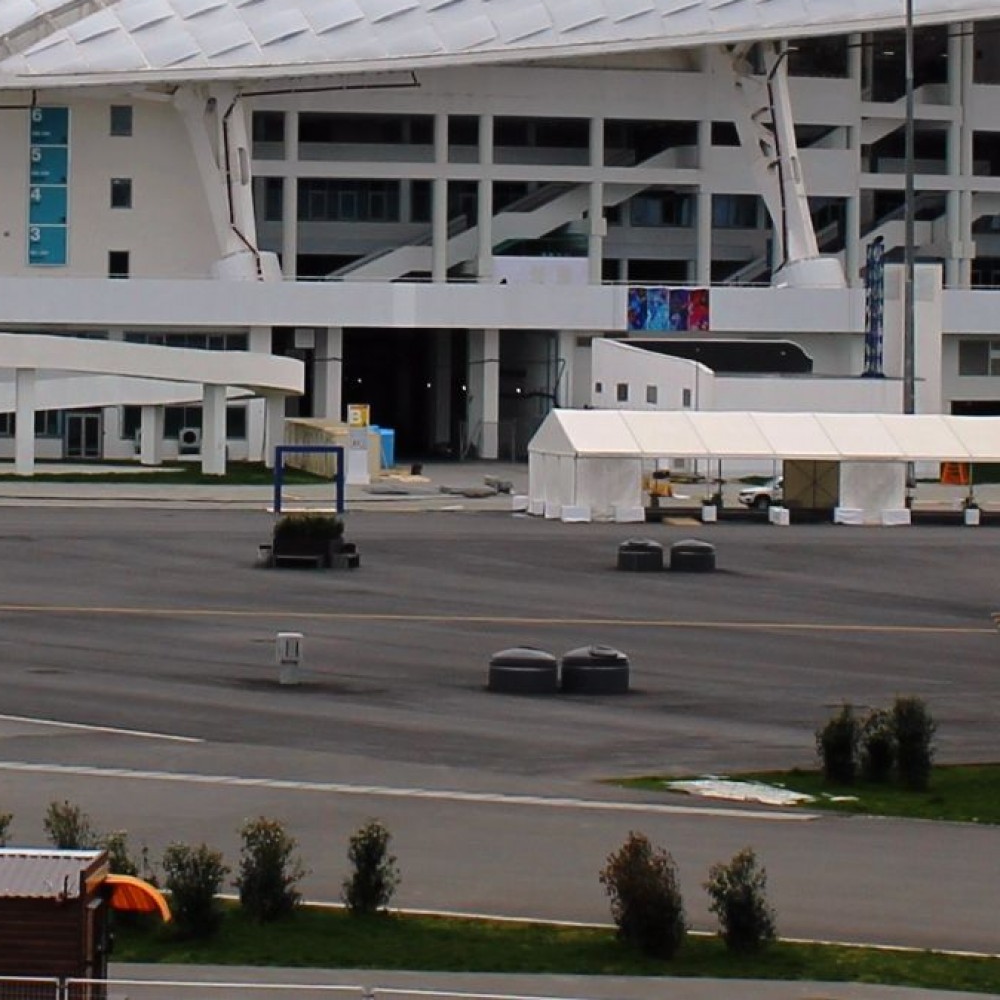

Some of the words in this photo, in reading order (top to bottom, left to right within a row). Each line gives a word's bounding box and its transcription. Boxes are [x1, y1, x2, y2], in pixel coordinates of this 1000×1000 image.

[32, 108, 42, 122] 6
[32, 147, 42, 161] 5
[30, 187, 41, 202] 4
[30, 226, 41, 241] 3
